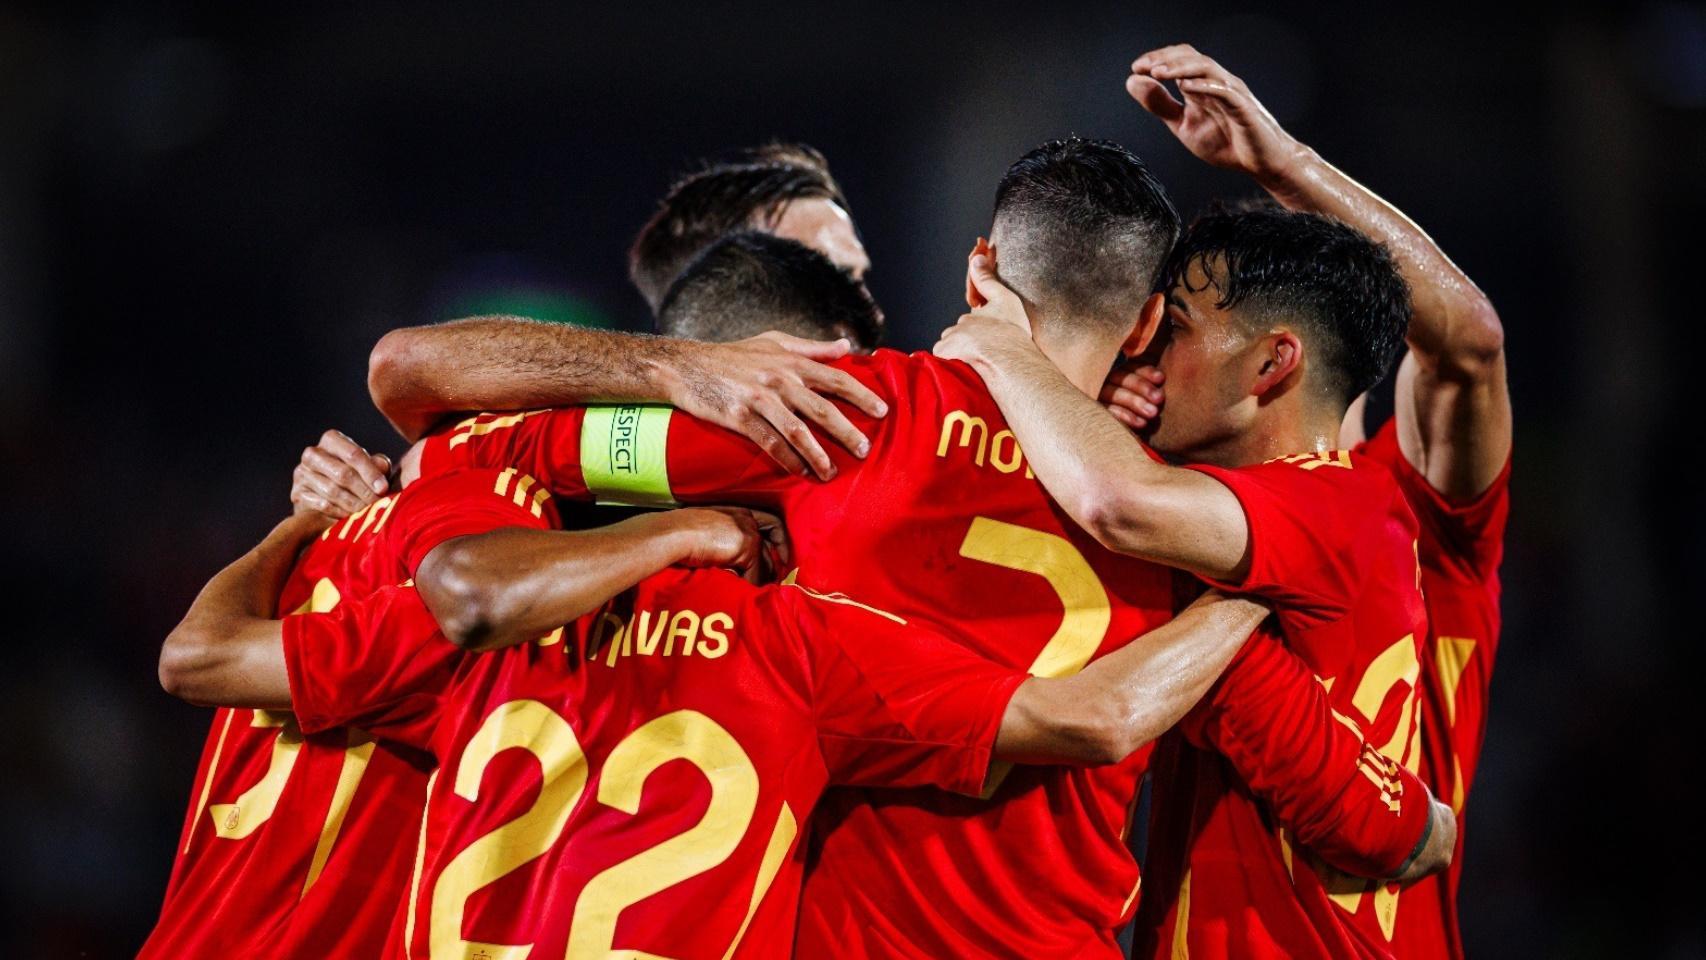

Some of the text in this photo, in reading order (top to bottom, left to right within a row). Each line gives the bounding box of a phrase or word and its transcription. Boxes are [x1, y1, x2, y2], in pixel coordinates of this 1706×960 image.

[614, 403, 637, 474] ESPECT
[936, 409, 1034, 480] MO
[429, 699, 760, 960] 22
